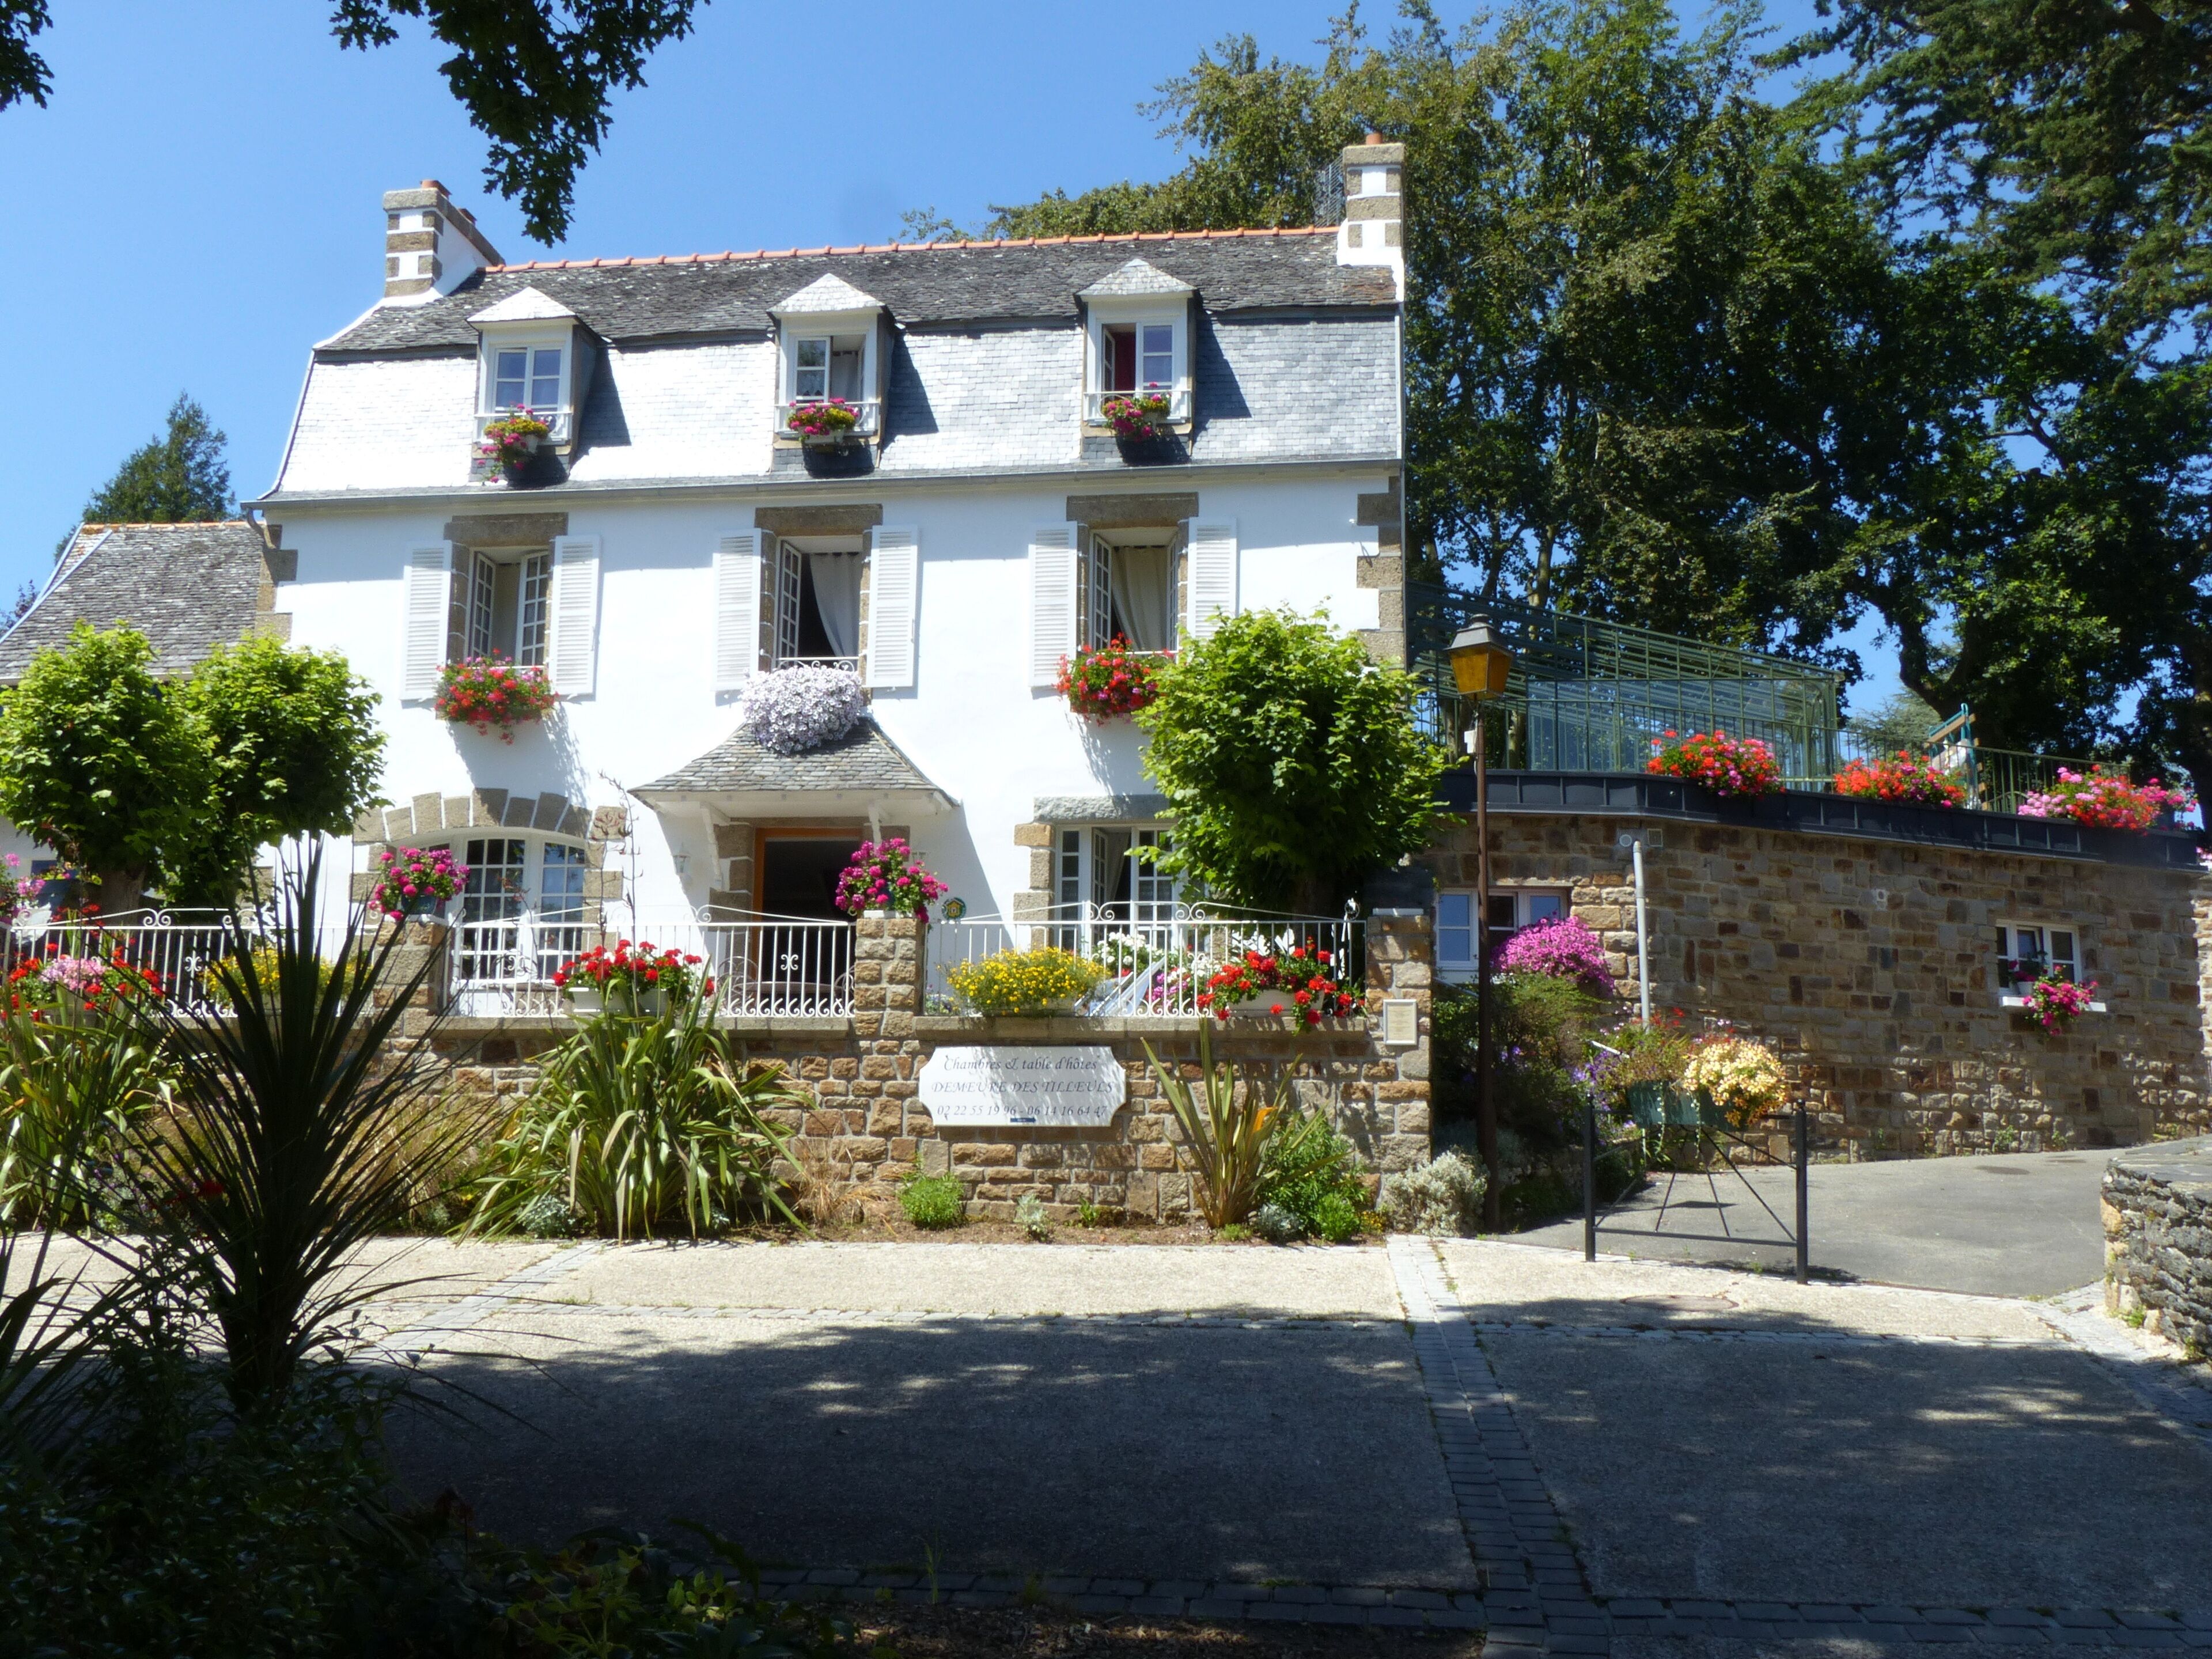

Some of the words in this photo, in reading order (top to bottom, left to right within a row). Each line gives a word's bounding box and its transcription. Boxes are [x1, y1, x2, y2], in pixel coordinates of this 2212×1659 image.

[944, 1056, 1001, 1071] Chambres
[1005, 1056, 1018, 1070] &
[1022, 1056, 1052, 1070] table
[1055, 1056, 1097, 1070] d'hôtes
[931, 1080, 1007, 1093] DEMEURE
[1011, 1081, 1039, 1093] DES
[1043, 1080, 1113, 1093] TILLEULS
[937, 1105, 950, 1115] 02
[954, 1105, 967, 1115] 22
[969, 1105, 983, 1115] 55
[987, 1105, 1000, 1115] 19
[1003, 1105, 1017, 1115] 96
[1027, 1105, 1040, 1115] 06
[1045, 1105, 1056, 1115] 14
[1061, 1105, 1074, 1115] 16
[1077, 1105, 1090, 1115] 64
[1094, 1105, 1108, 1116] 47
